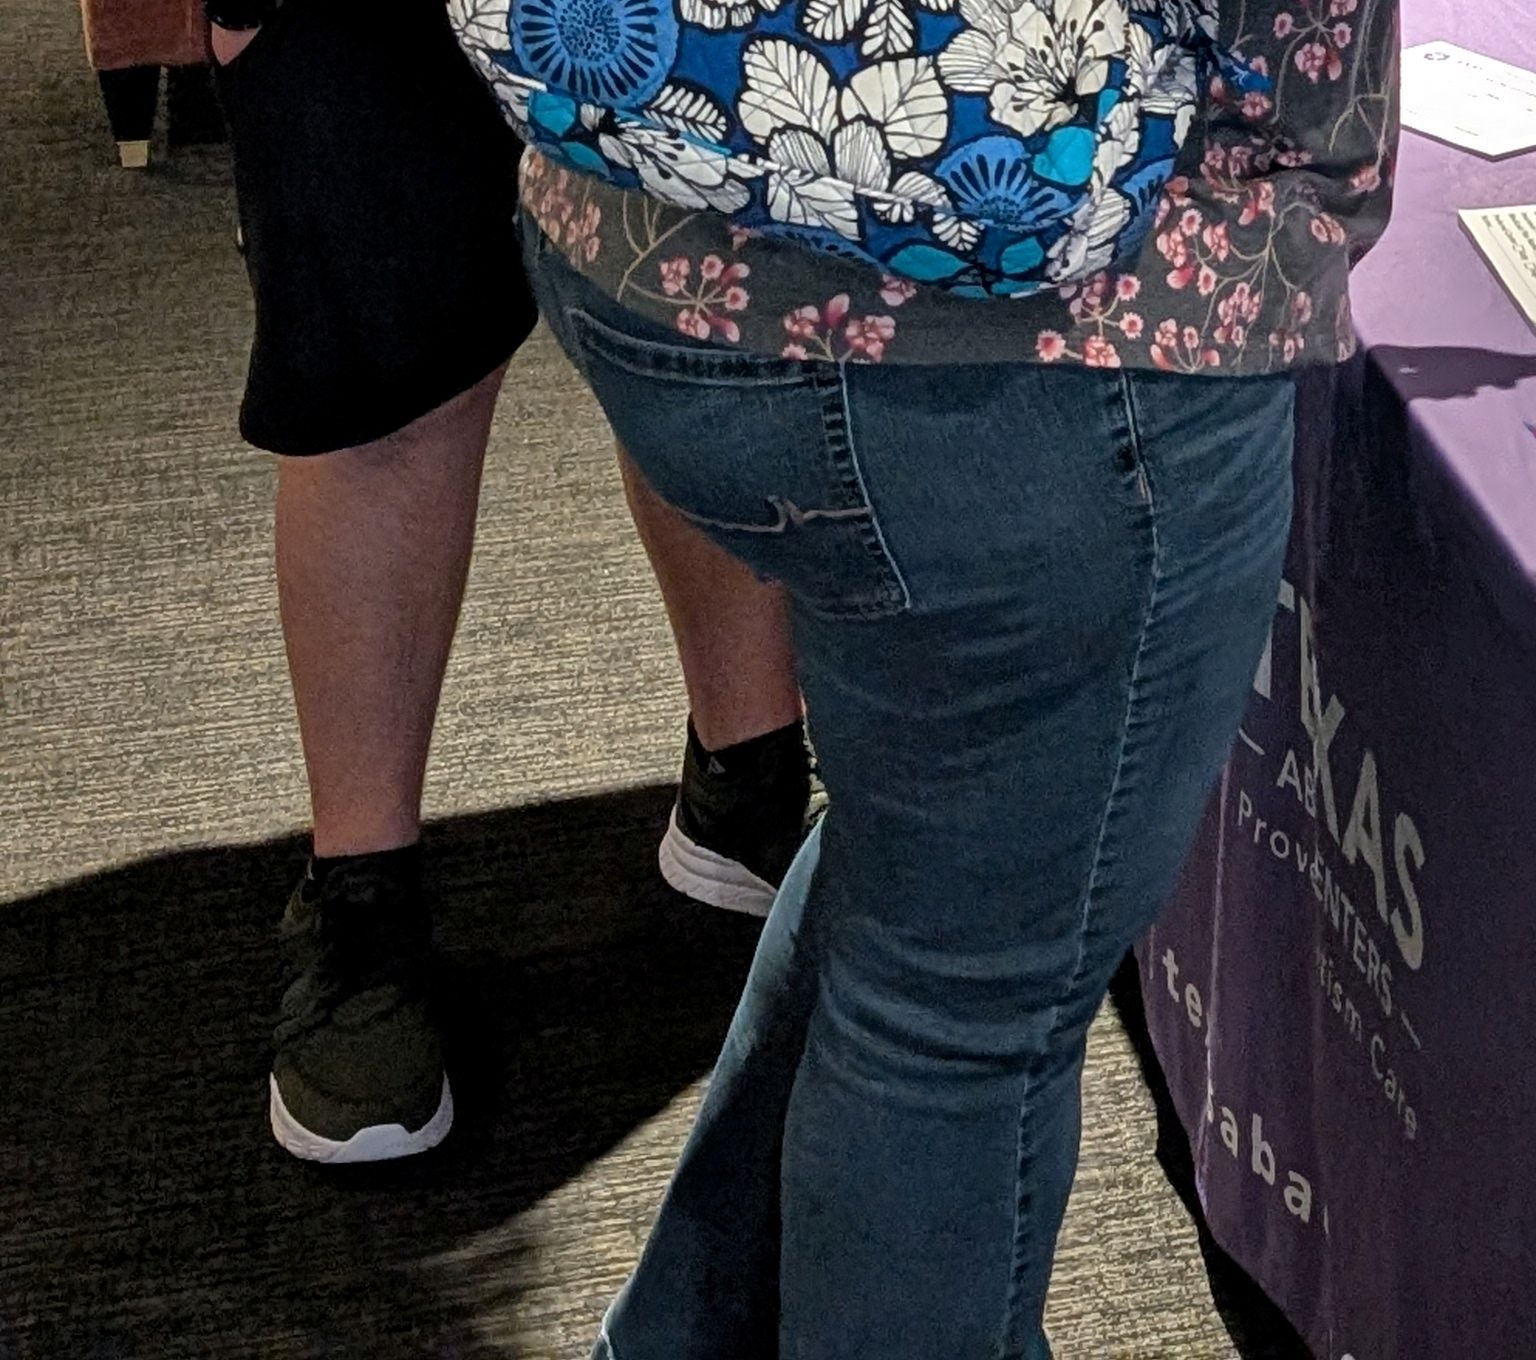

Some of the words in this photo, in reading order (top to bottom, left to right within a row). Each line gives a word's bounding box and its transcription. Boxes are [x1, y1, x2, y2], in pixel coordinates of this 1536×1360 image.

[1237, 789, 1309, 873] Prov
[1316, 946, 1364, 1045] tism
[1369, 1032, 1418, 1141] Care
[1276, 748, 1318, 820] AB
[1311, 847, 1393, 1018] ENTERS
